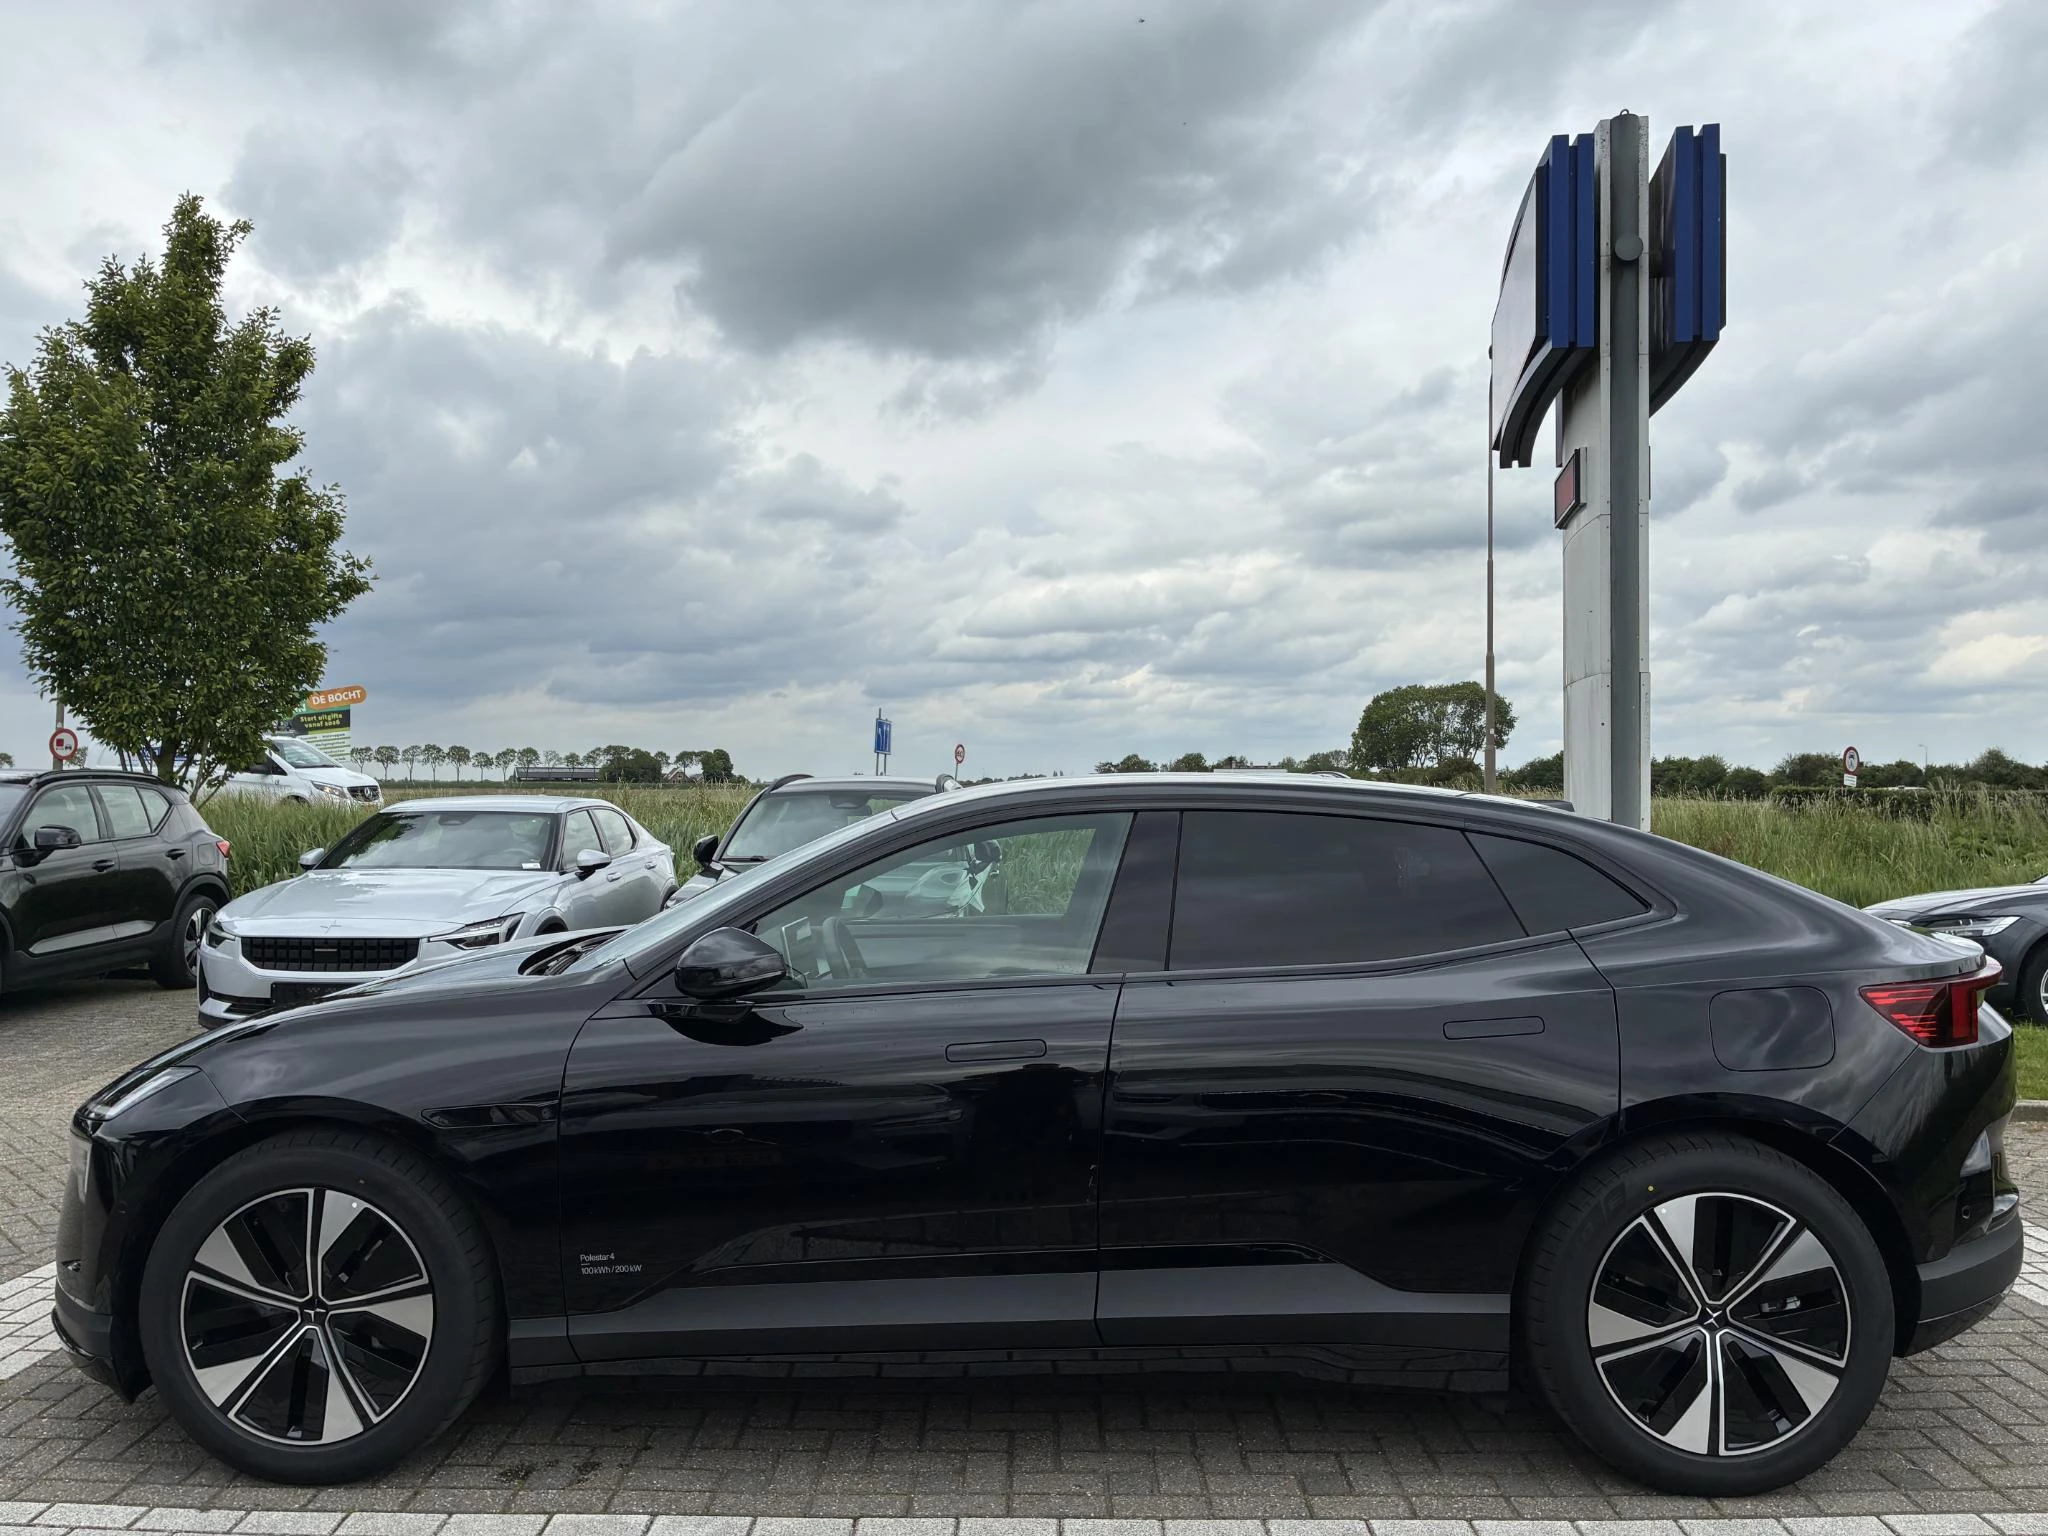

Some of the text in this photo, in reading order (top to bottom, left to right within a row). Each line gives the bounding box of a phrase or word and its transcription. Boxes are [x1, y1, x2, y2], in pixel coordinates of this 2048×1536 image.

[312, 689, 361, 705] DE BOCHT
[304, 720, 323, 728] vanaf
[580, 1252, 615, 1262] Polestar 4
